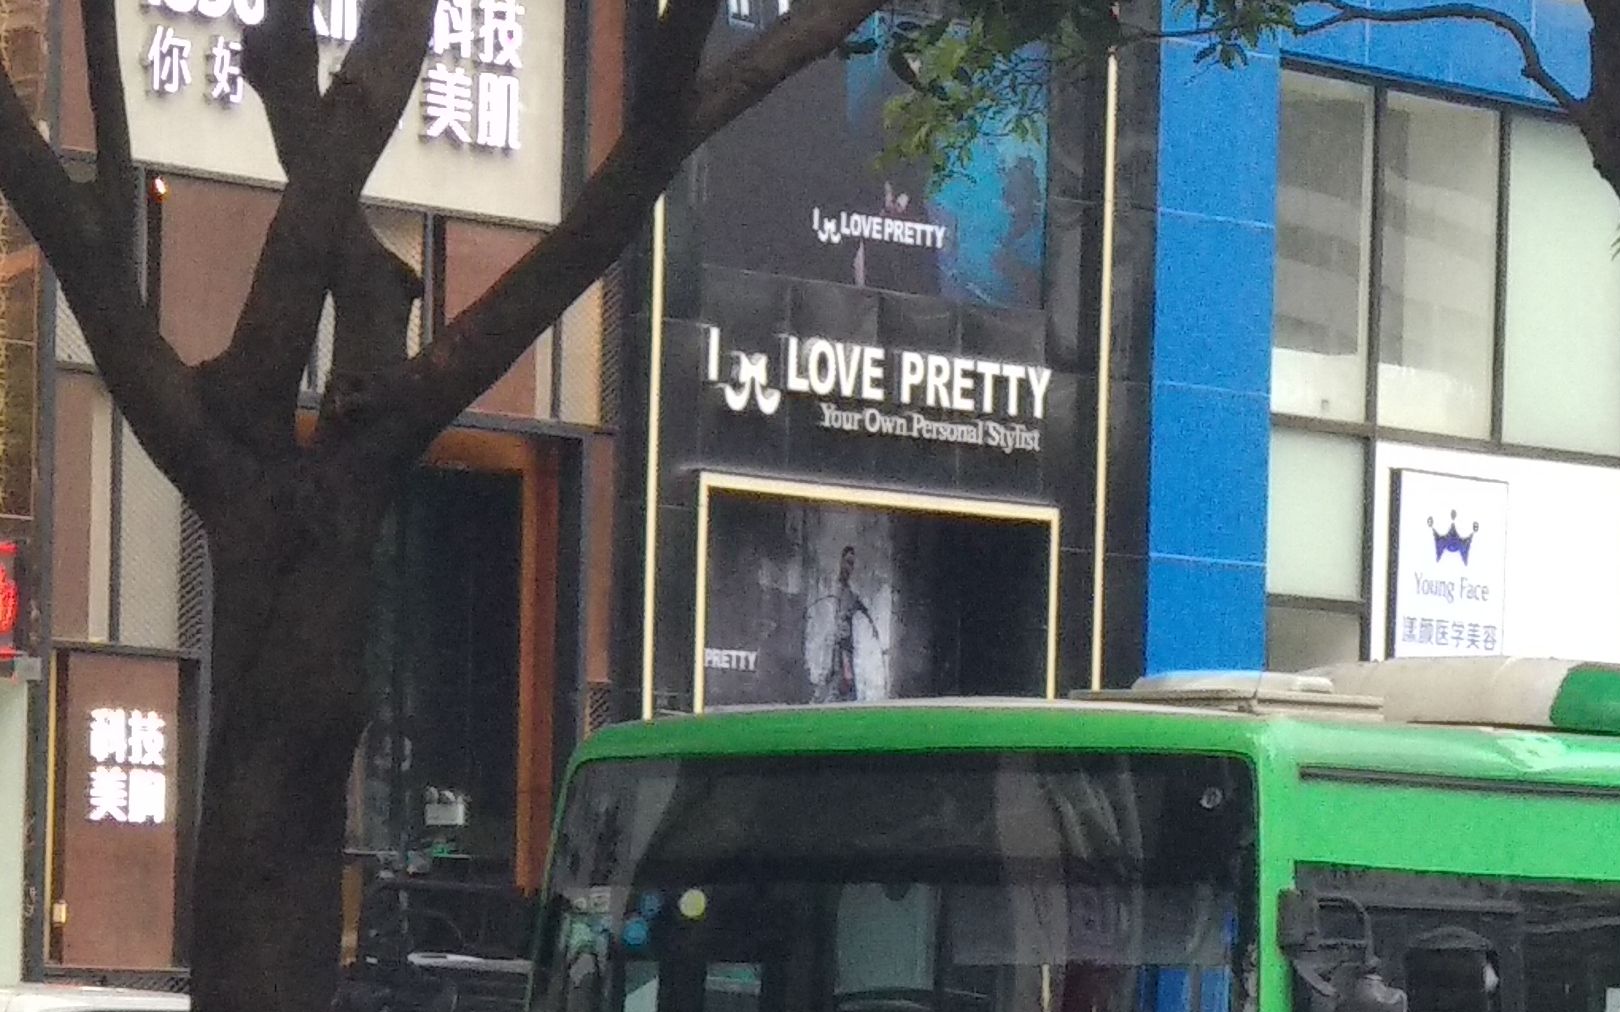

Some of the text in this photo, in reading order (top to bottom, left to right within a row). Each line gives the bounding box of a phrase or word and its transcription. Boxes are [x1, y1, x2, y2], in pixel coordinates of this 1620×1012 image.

[840, 211, 883, 240] LOVE
[883, 218, 946, 249] PRETTY
[786, 336, 886, 402] LOVE
[900, 351, 1052, 419] PRETTY
[821, 402, 1042, 453] Your Own Personal Stylist
[1414, 571, 1490, 604] Young Face
[90, 708, 165, 765] 科技
